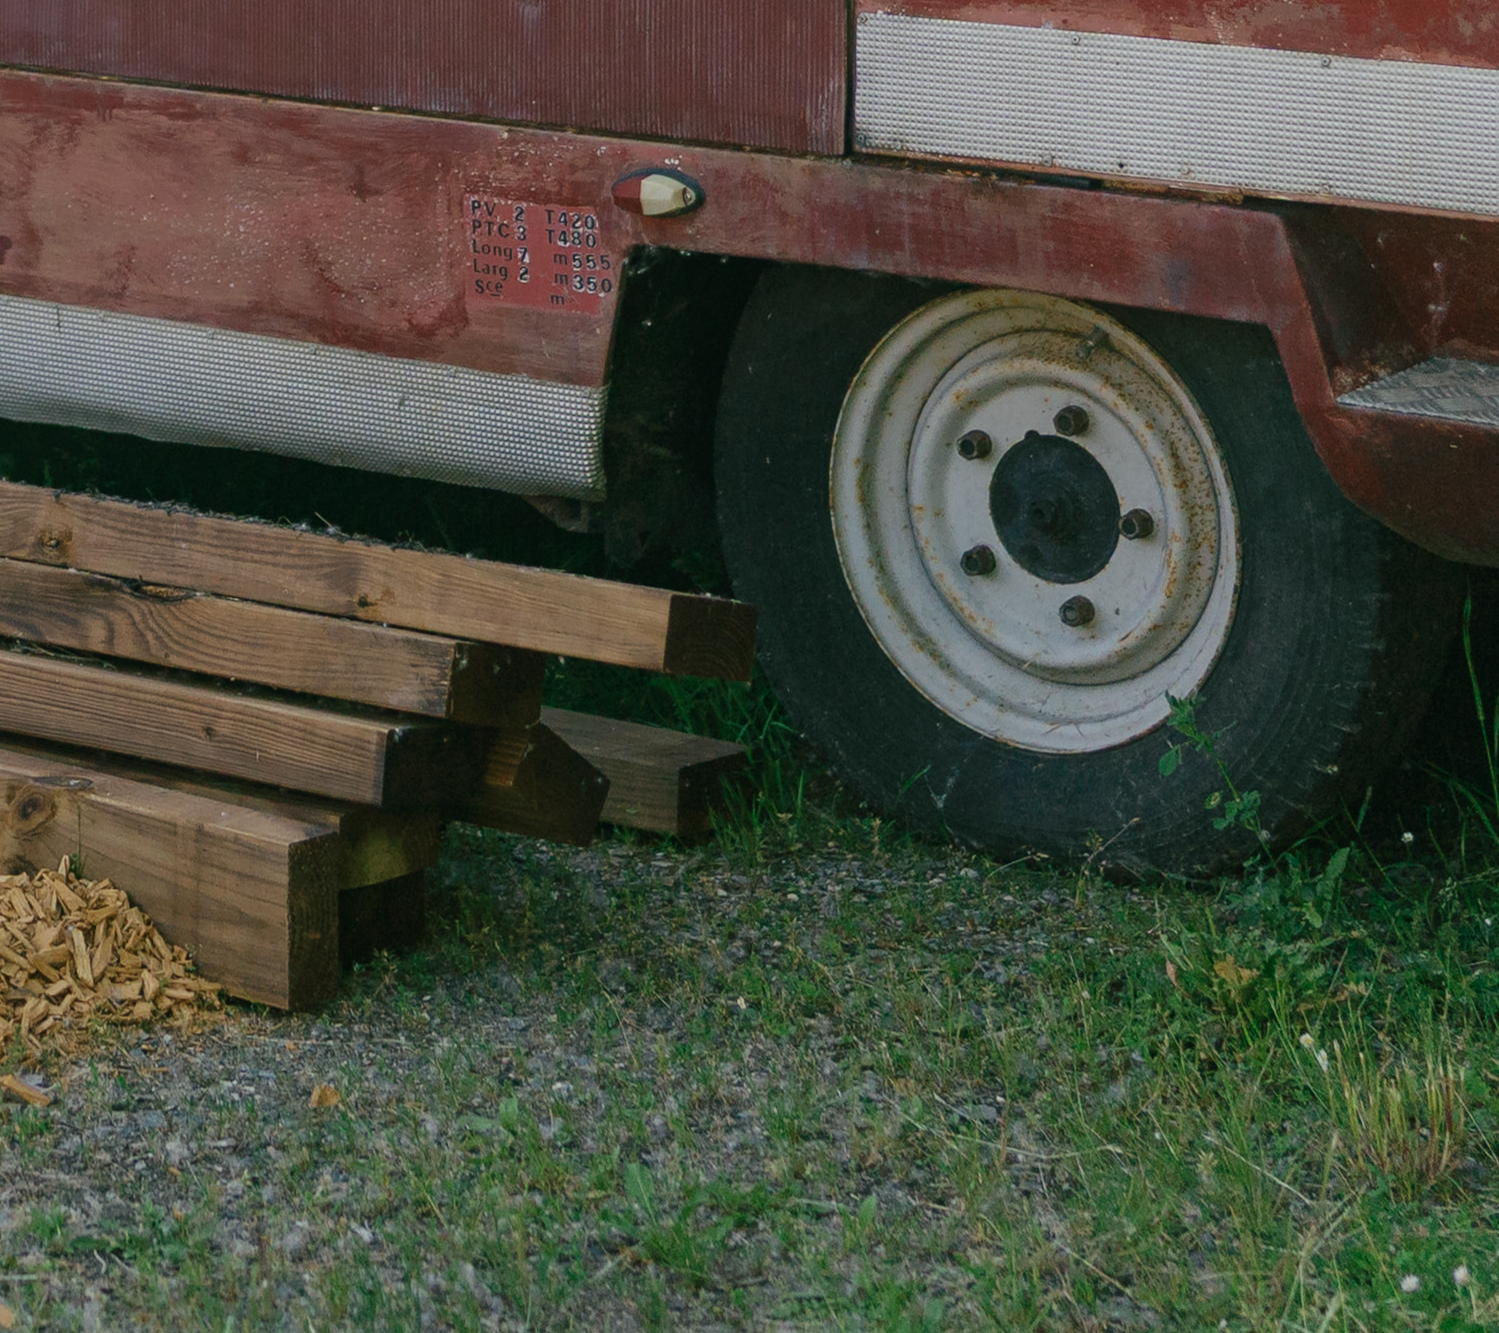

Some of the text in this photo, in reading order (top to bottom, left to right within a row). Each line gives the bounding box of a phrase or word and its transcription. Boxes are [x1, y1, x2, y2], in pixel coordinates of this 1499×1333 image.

[514, 205, 526, 222] 2
[516, 224, 528, 242] 3
[518, 265, 530, 282] 2
